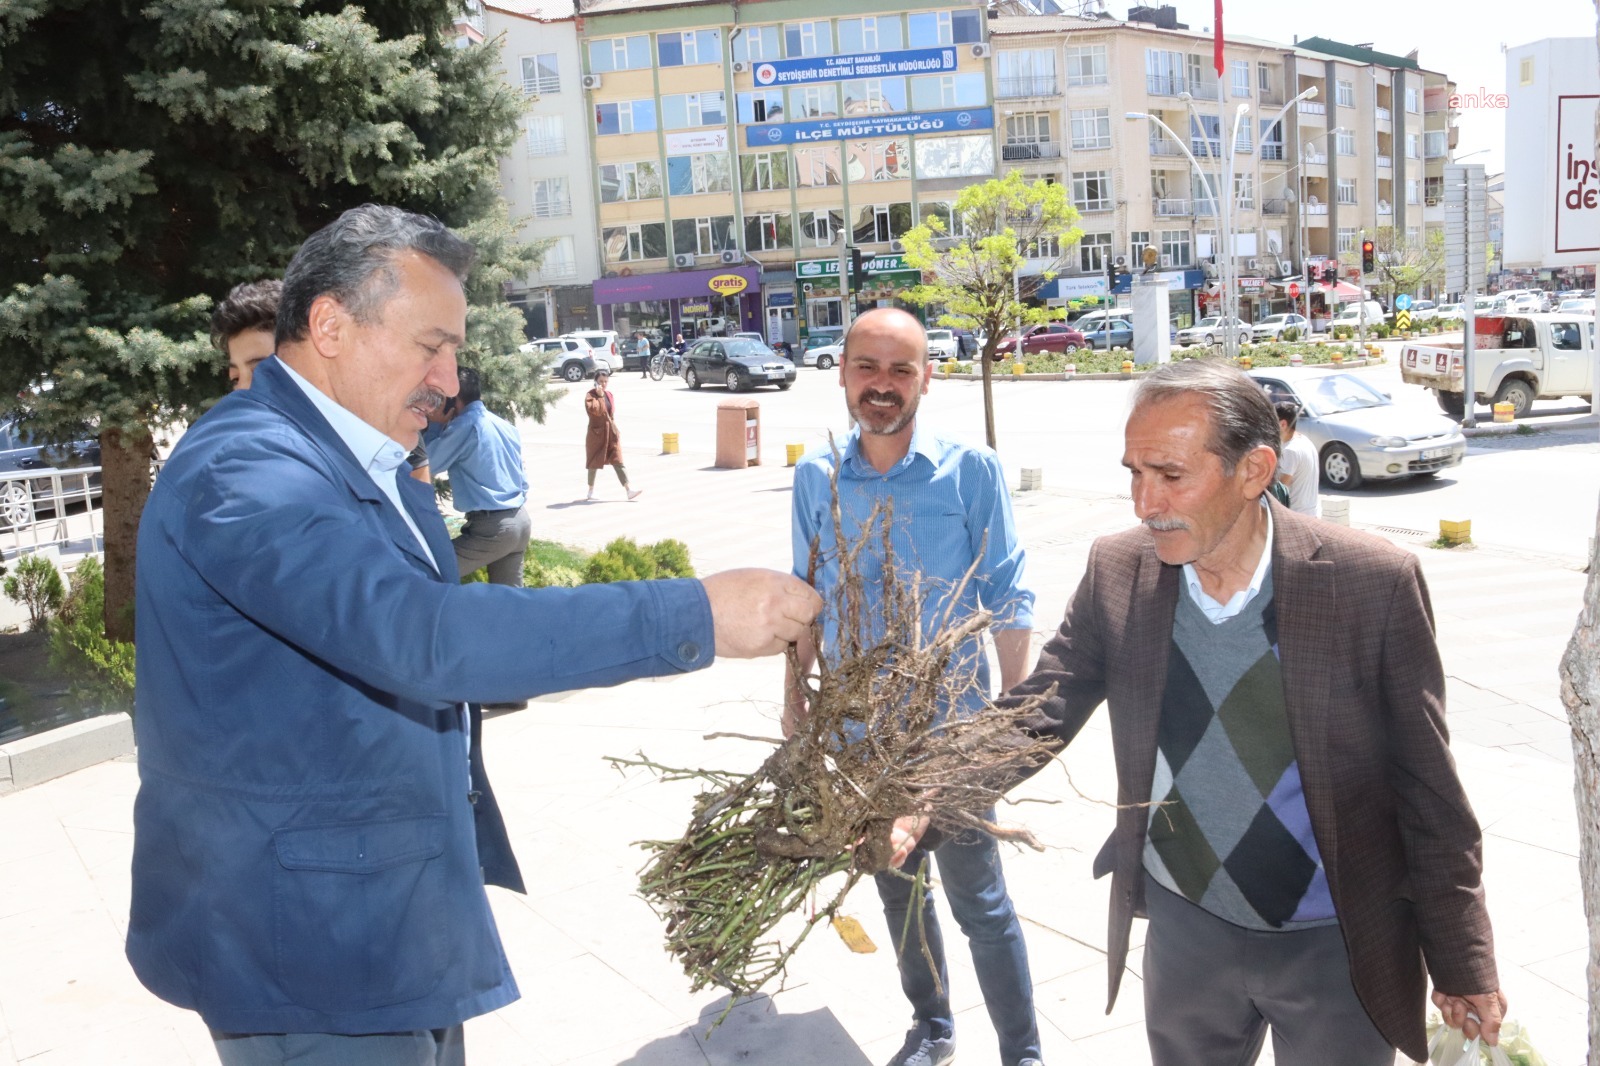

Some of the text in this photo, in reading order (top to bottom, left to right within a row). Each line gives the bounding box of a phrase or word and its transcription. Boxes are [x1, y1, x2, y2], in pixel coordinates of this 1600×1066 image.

[778, 58, 941, 82] SEYDİŞEHİR DENETİMLİ SERBESTLİK MÜDÜRLÜĞÜ
[795, 119, 944, 140] İLÇE MÜFTÜLÜĞÜ
[1565, 181, 1600, 210] de
[862, 258, 898, 271] DÖNER
[713, 277, 743, 289] gratis
